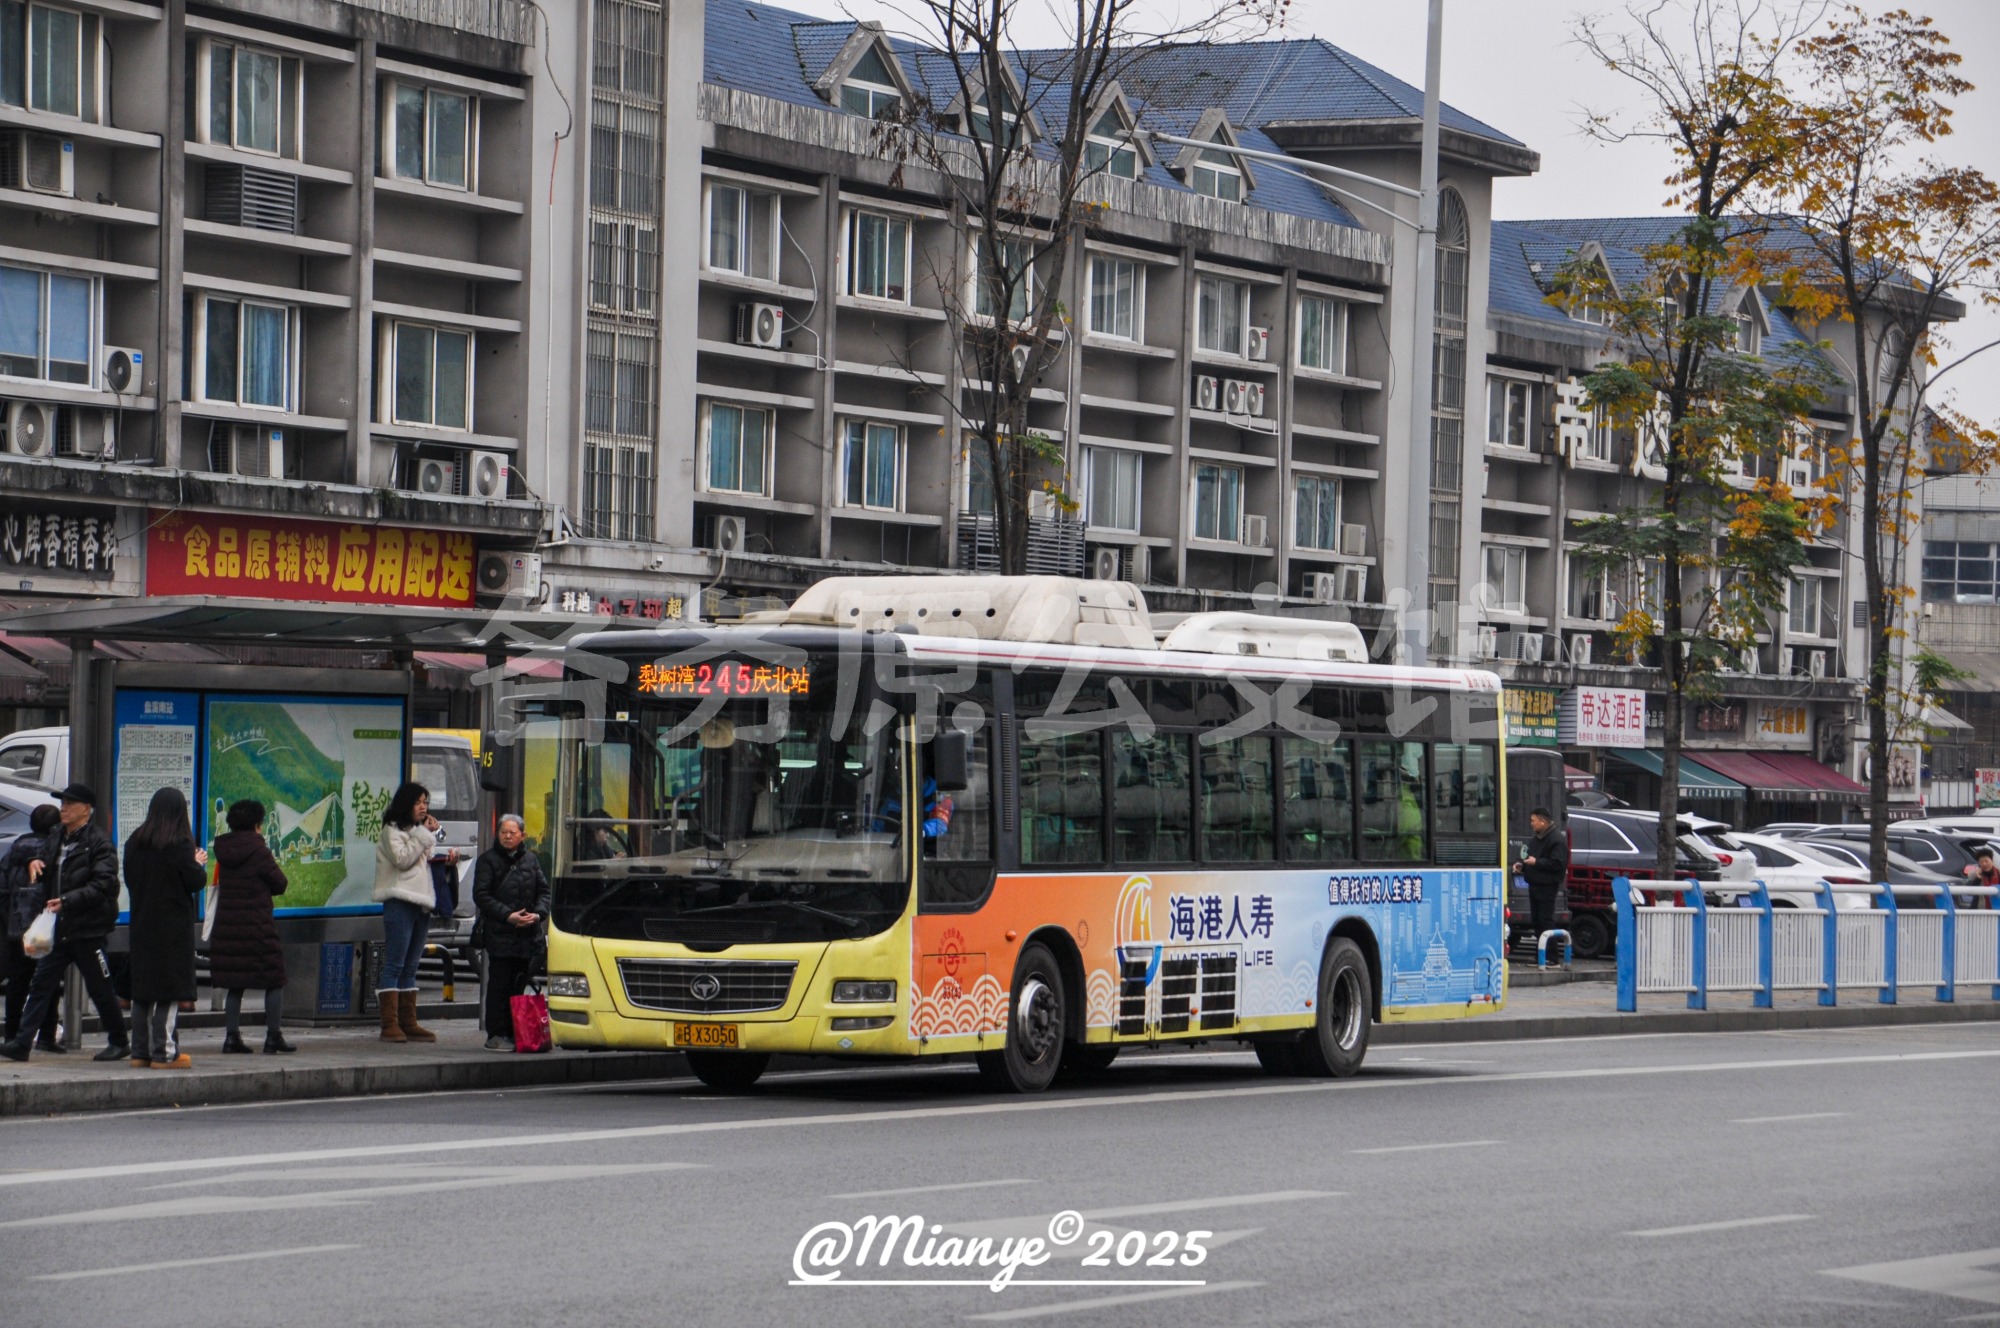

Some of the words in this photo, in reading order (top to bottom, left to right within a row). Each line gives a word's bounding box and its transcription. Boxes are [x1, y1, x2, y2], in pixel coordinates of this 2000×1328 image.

[183, 524, 474, 602] 食品原辅料应用配送
[1581, 690, 1642, 730] 帝达酒店
[1328, 875, 1423, 905] 值得托付的人生港湾
[1169, 894, 1274, 941] 海港人寿
[1244, 950, 1273, 967] LIFE
